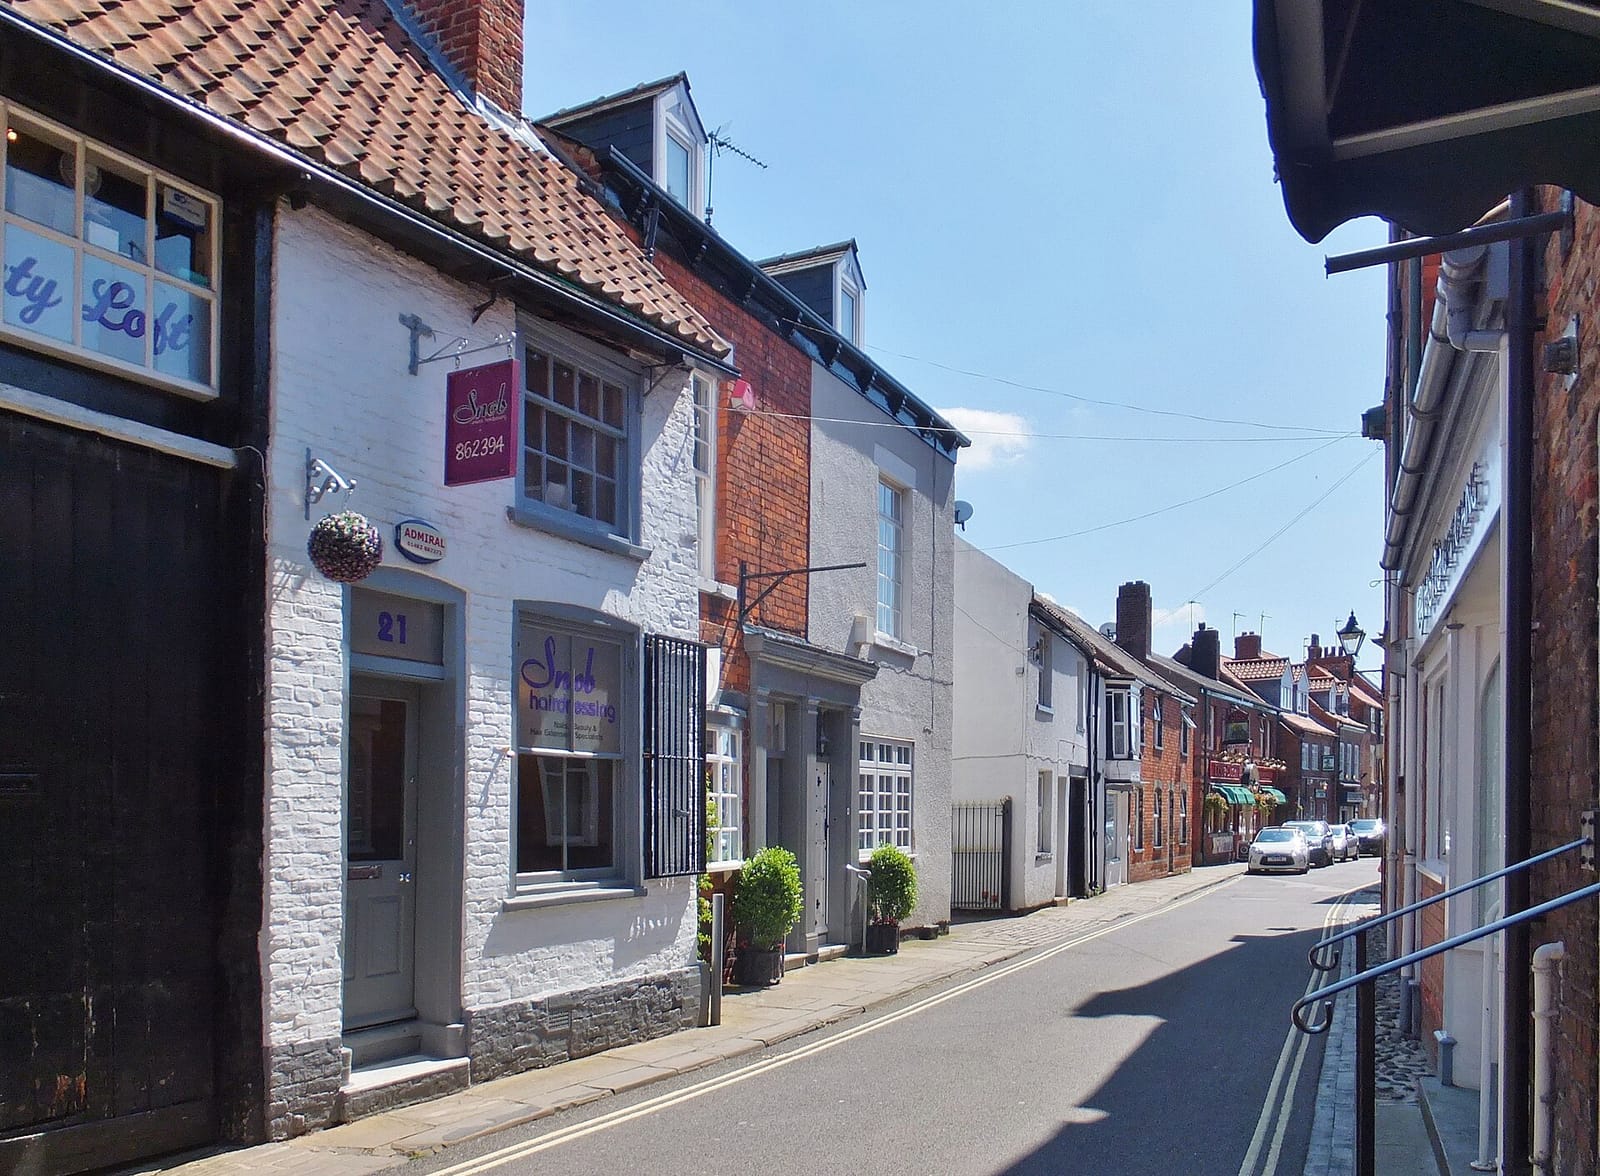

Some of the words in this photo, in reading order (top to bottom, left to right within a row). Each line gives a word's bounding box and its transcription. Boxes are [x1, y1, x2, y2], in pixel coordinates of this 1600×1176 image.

[82, 279, 194, 356] Loft
[453, 382, 508, 425] Snob
[455, 435, 505, 461] 862394
[404, 527, 446, 549] ADMIRAL
[377, 611, 407, 645] 21
[521, 636, 595, 693] Snob
